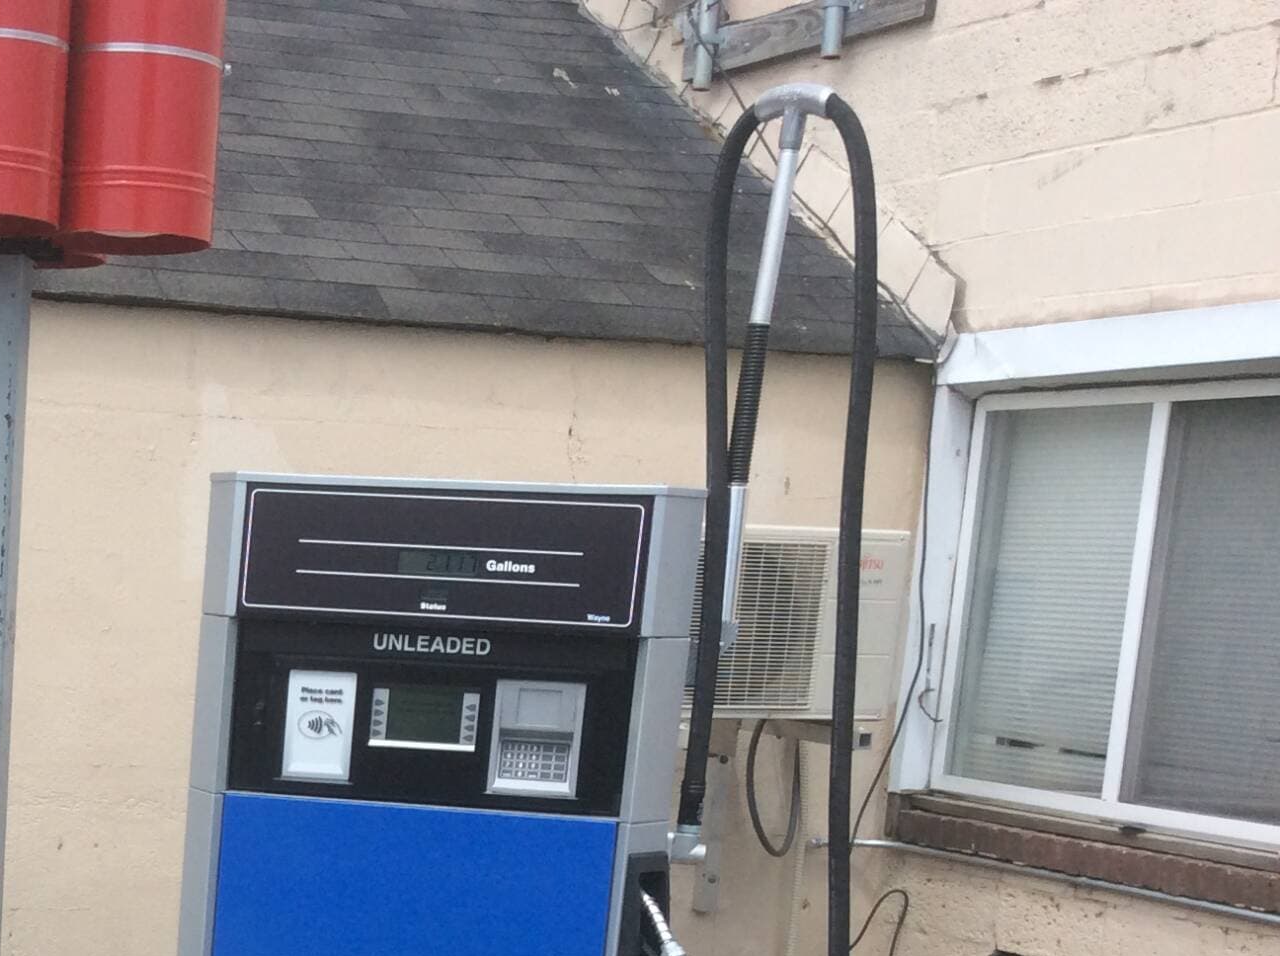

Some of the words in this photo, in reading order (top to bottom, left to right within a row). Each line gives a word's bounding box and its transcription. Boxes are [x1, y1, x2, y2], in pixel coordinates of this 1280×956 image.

[486, 559, 535, 574] Gallons
[420, 602, 447, 611] Status
[373, 633, 491, 656] UNLEADED
